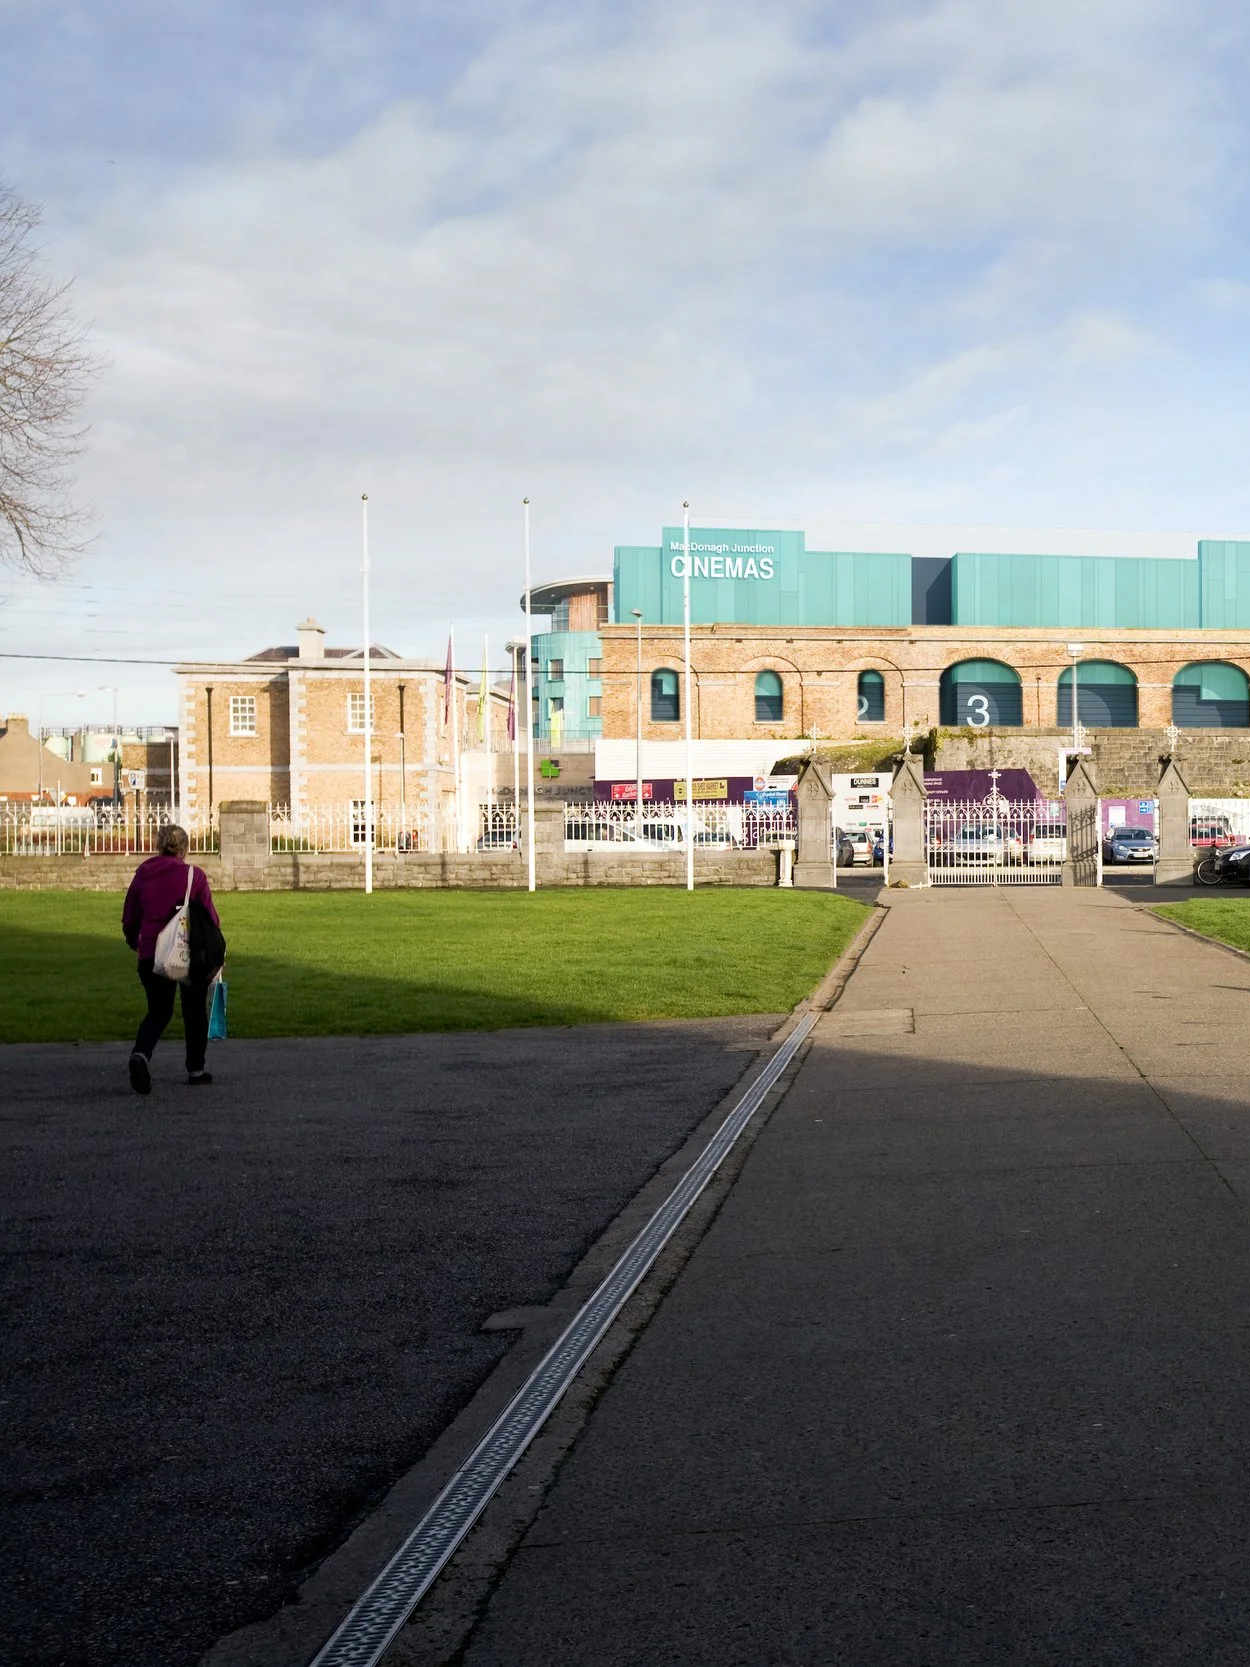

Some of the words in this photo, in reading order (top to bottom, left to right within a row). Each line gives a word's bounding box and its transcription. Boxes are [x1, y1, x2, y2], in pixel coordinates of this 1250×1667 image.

[670, 542, 729, 553] MacDonagh
[731, 543, 774, 553] Junction
[670, 555, 774, 579] CINEMAS
[966, 694, 991, 728] 3
[853, 777, 877, 786] DUNNES
